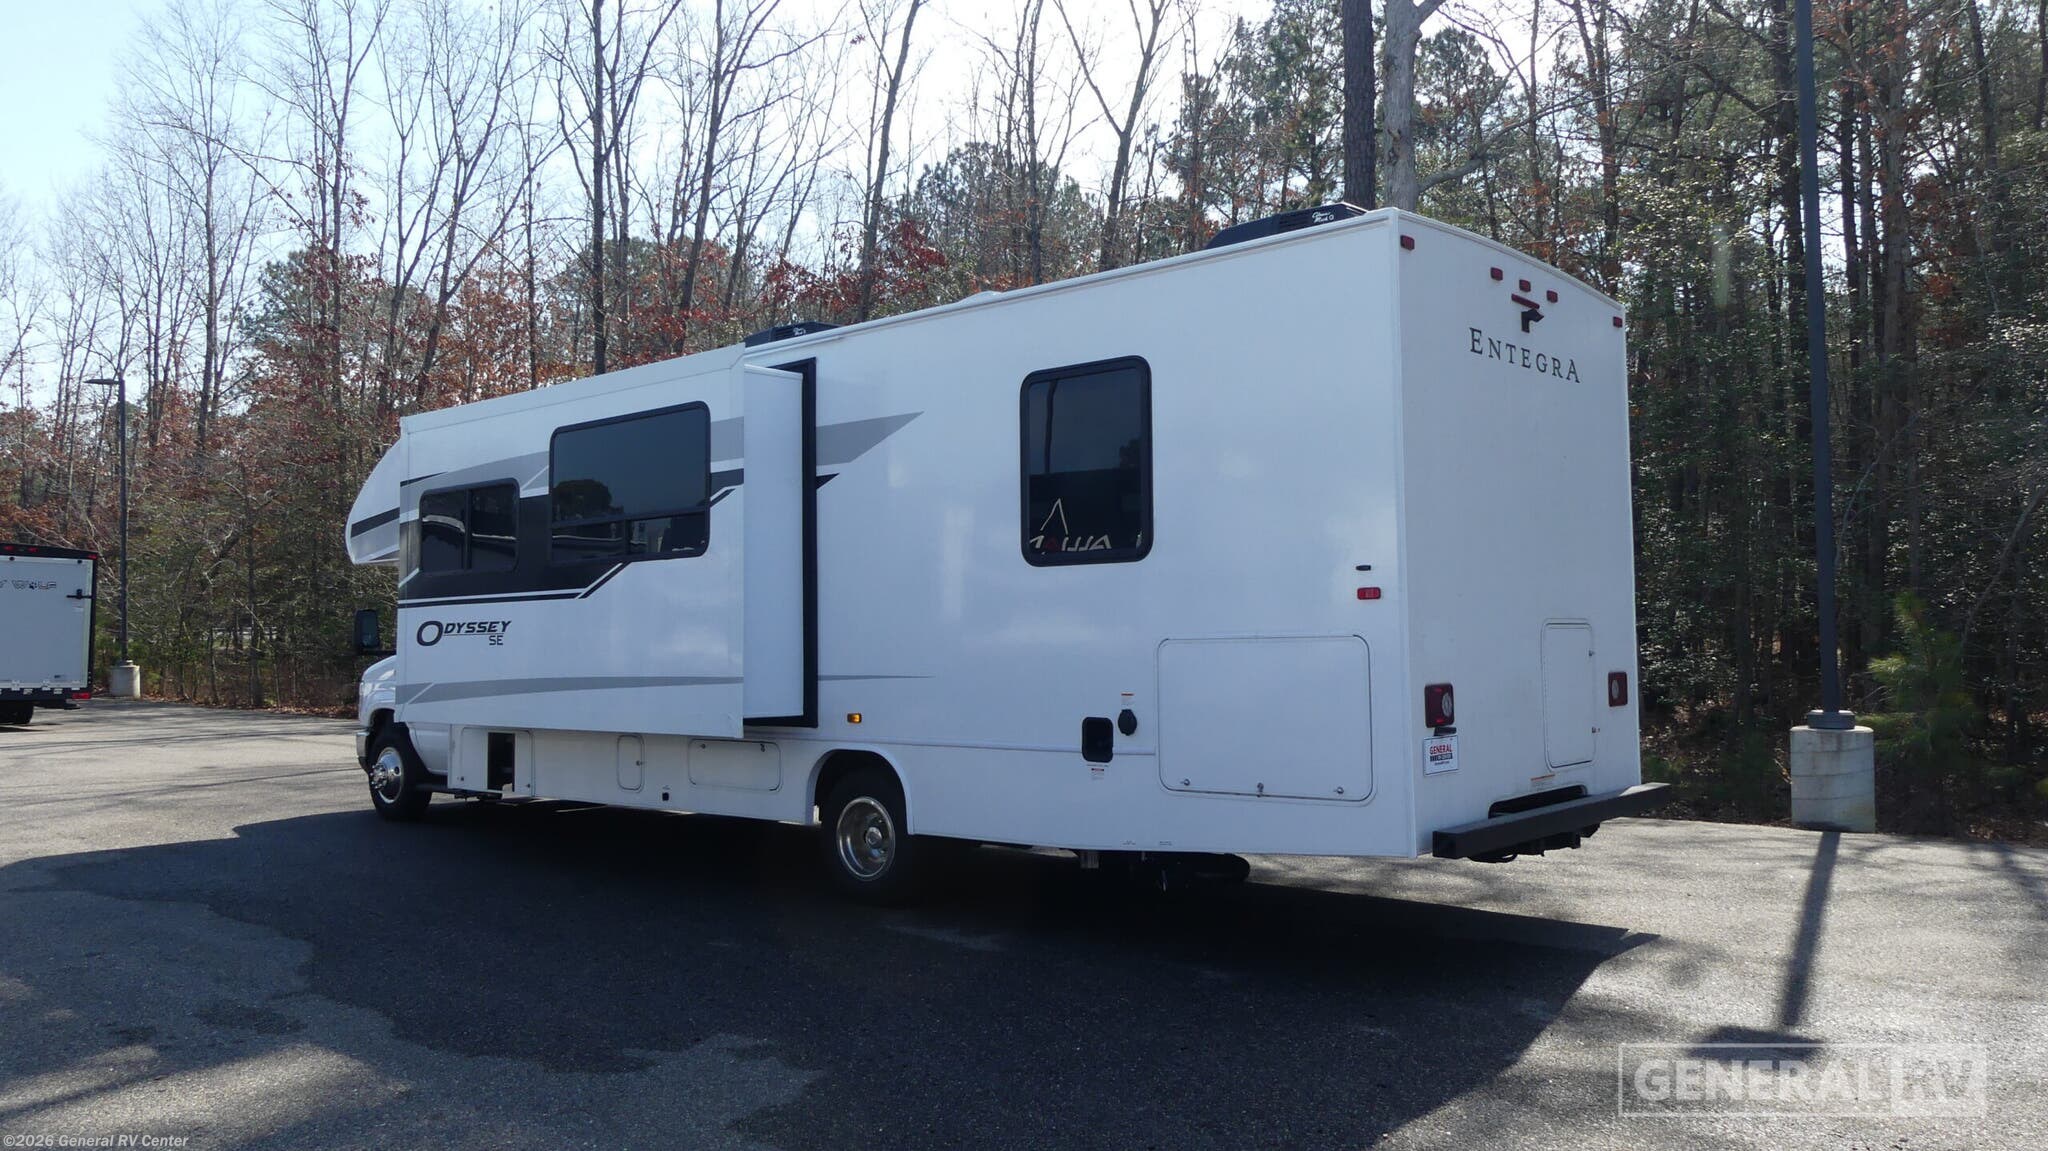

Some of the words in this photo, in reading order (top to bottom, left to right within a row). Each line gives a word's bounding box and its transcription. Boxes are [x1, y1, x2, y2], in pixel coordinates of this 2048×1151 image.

[1469, 327, 1581, 384] ENTEGRA
[416, 620, 512, 647] ODYSSEY
[488, 635, 504, 646] SE
[1429, 743, 1453, 755] GENERAL
